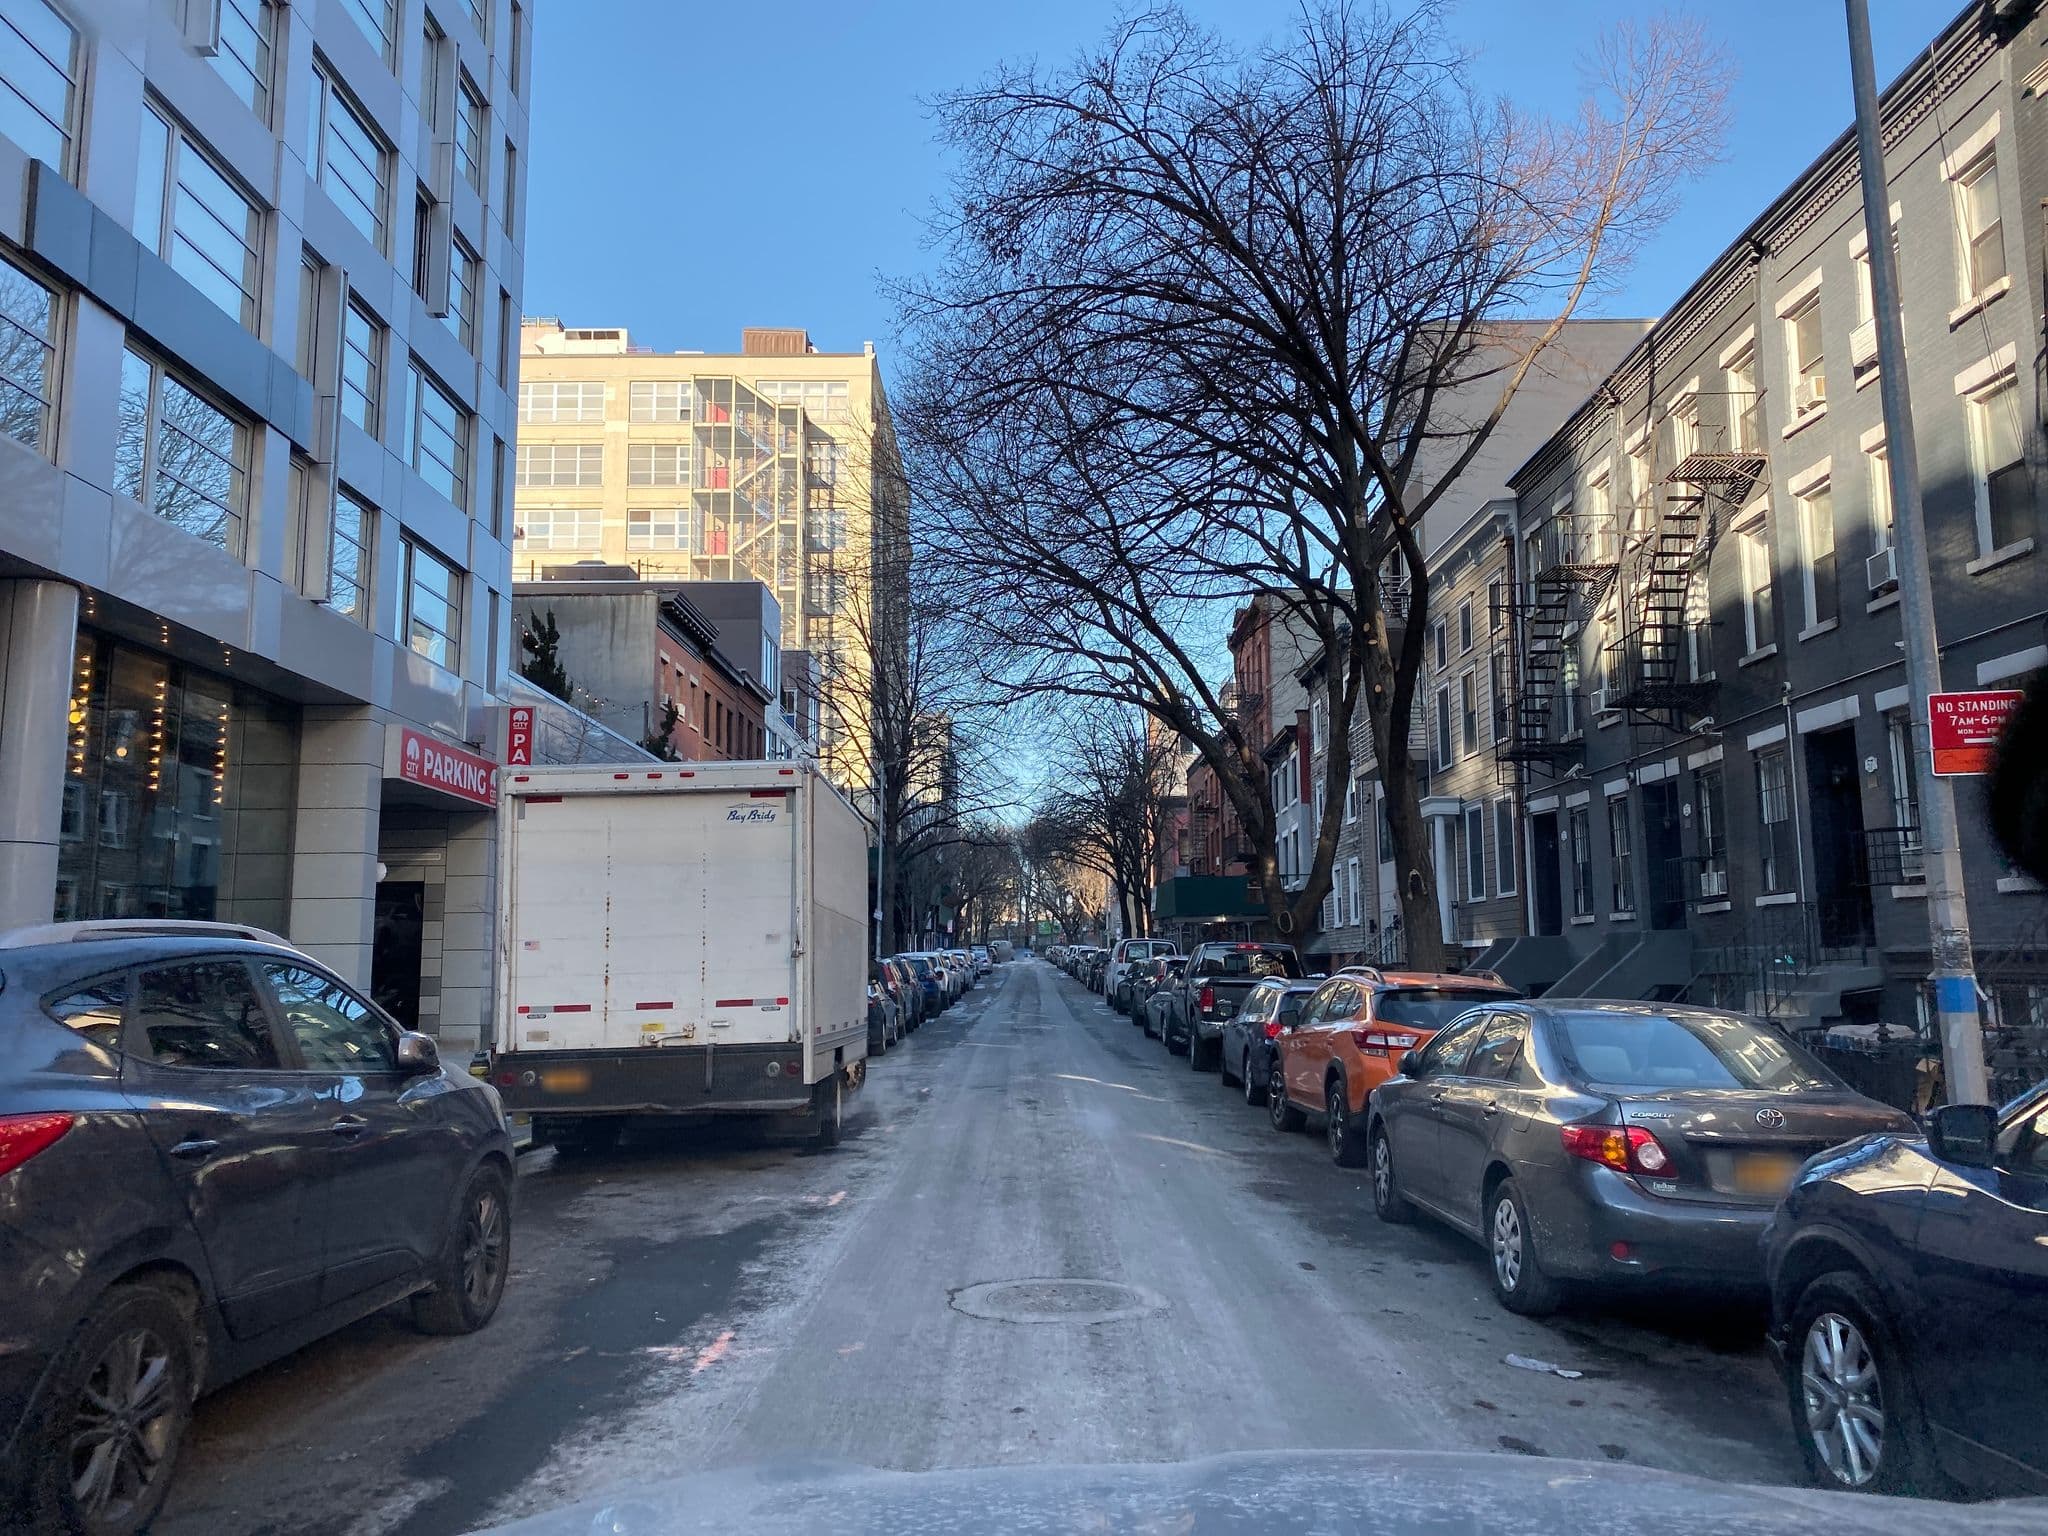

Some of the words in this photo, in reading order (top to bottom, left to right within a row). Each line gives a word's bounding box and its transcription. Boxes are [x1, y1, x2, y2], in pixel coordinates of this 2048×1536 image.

[1937, 702, 1953, 713] NO
[1958, 699, 2017, 712] STANDING
[512, 721, 528, 729] CITY
[406, 761, 418, 774] CITY
[424, 748, 486, 794] PARKING
[727, 809, 746, 823] Bay
